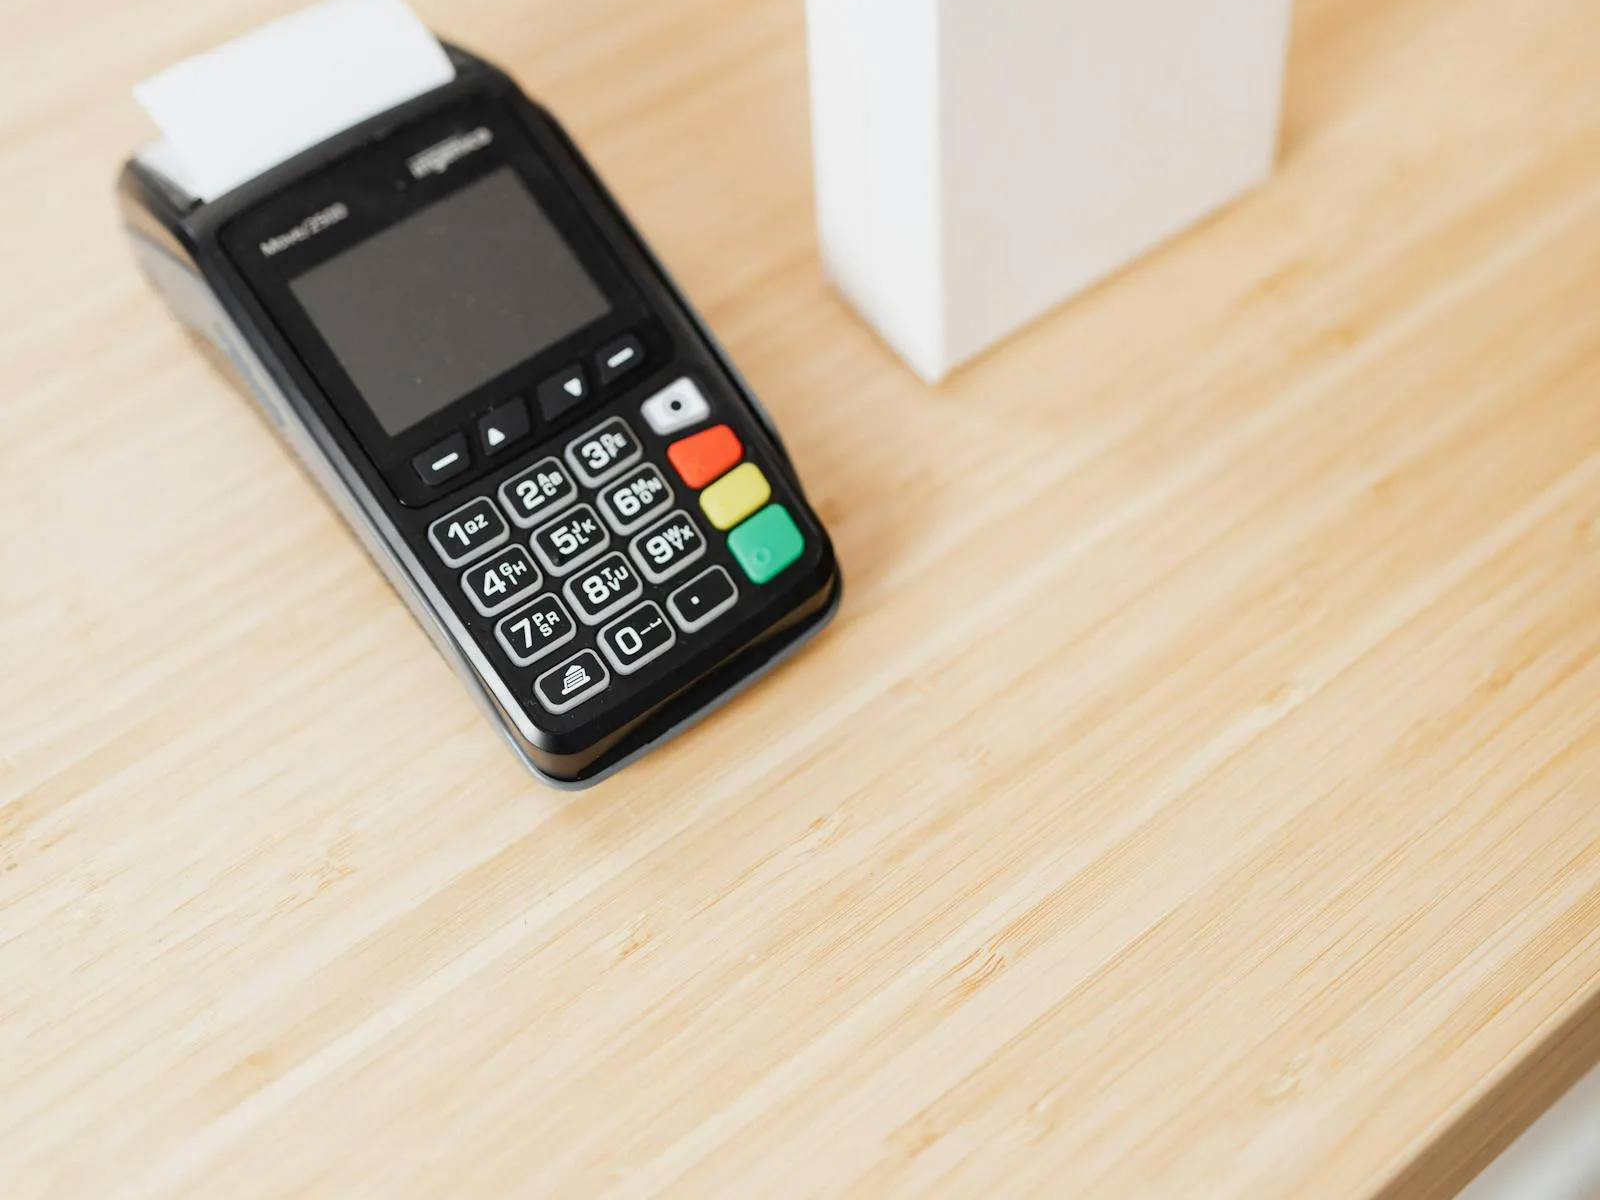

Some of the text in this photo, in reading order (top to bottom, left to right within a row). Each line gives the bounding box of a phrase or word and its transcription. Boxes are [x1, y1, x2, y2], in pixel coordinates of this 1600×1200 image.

[581, 441, 610, 469] 3
[516, 480, 545, 510] 2
[613, 488, 641, 516] 6
[447, 522, 470, 546] 1
[550, 525, 579, 555] 5
[646, 535, 674, 564] 9
[483, 569, 507, 596] 4
[582, 575, 610, 604] 8
[510, 617, 533, 649] 7
[614, 626, 643, 656] 0
